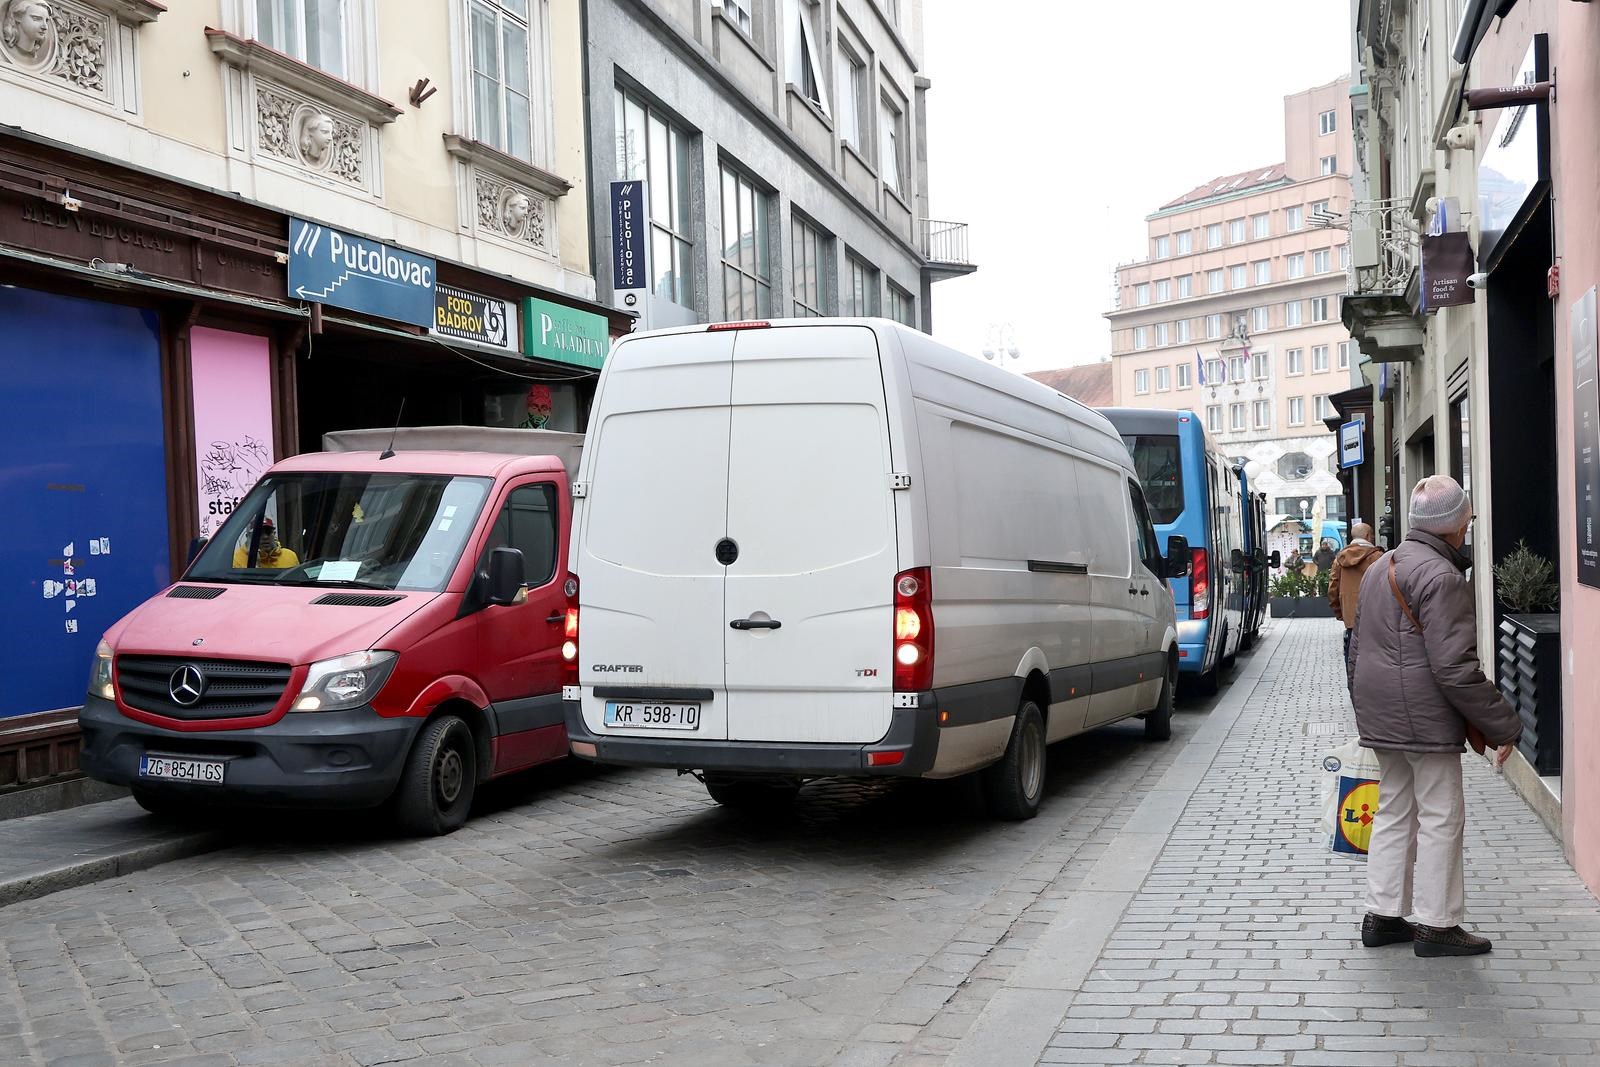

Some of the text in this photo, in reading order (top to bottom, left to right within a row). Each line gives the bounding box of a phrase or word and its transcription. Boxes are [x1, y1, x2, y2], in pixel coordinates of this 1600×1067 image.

[623, 200, 634, 285] Putolovac
[329, 231, 431, 288] Putolovac
[1433, 278, 1457, 286] Artisan
[447, 296, 472, 316] FOTO
[437, 307, 482, 334] BADROV
[540, 313, 604, 357] PALADIUM
[592, 664, 643, 673] CRAFTER
[855, 669, 877, 677] TDI
[615, 705, 633, 722] KR
[148, 759, 163, 776] ZG
